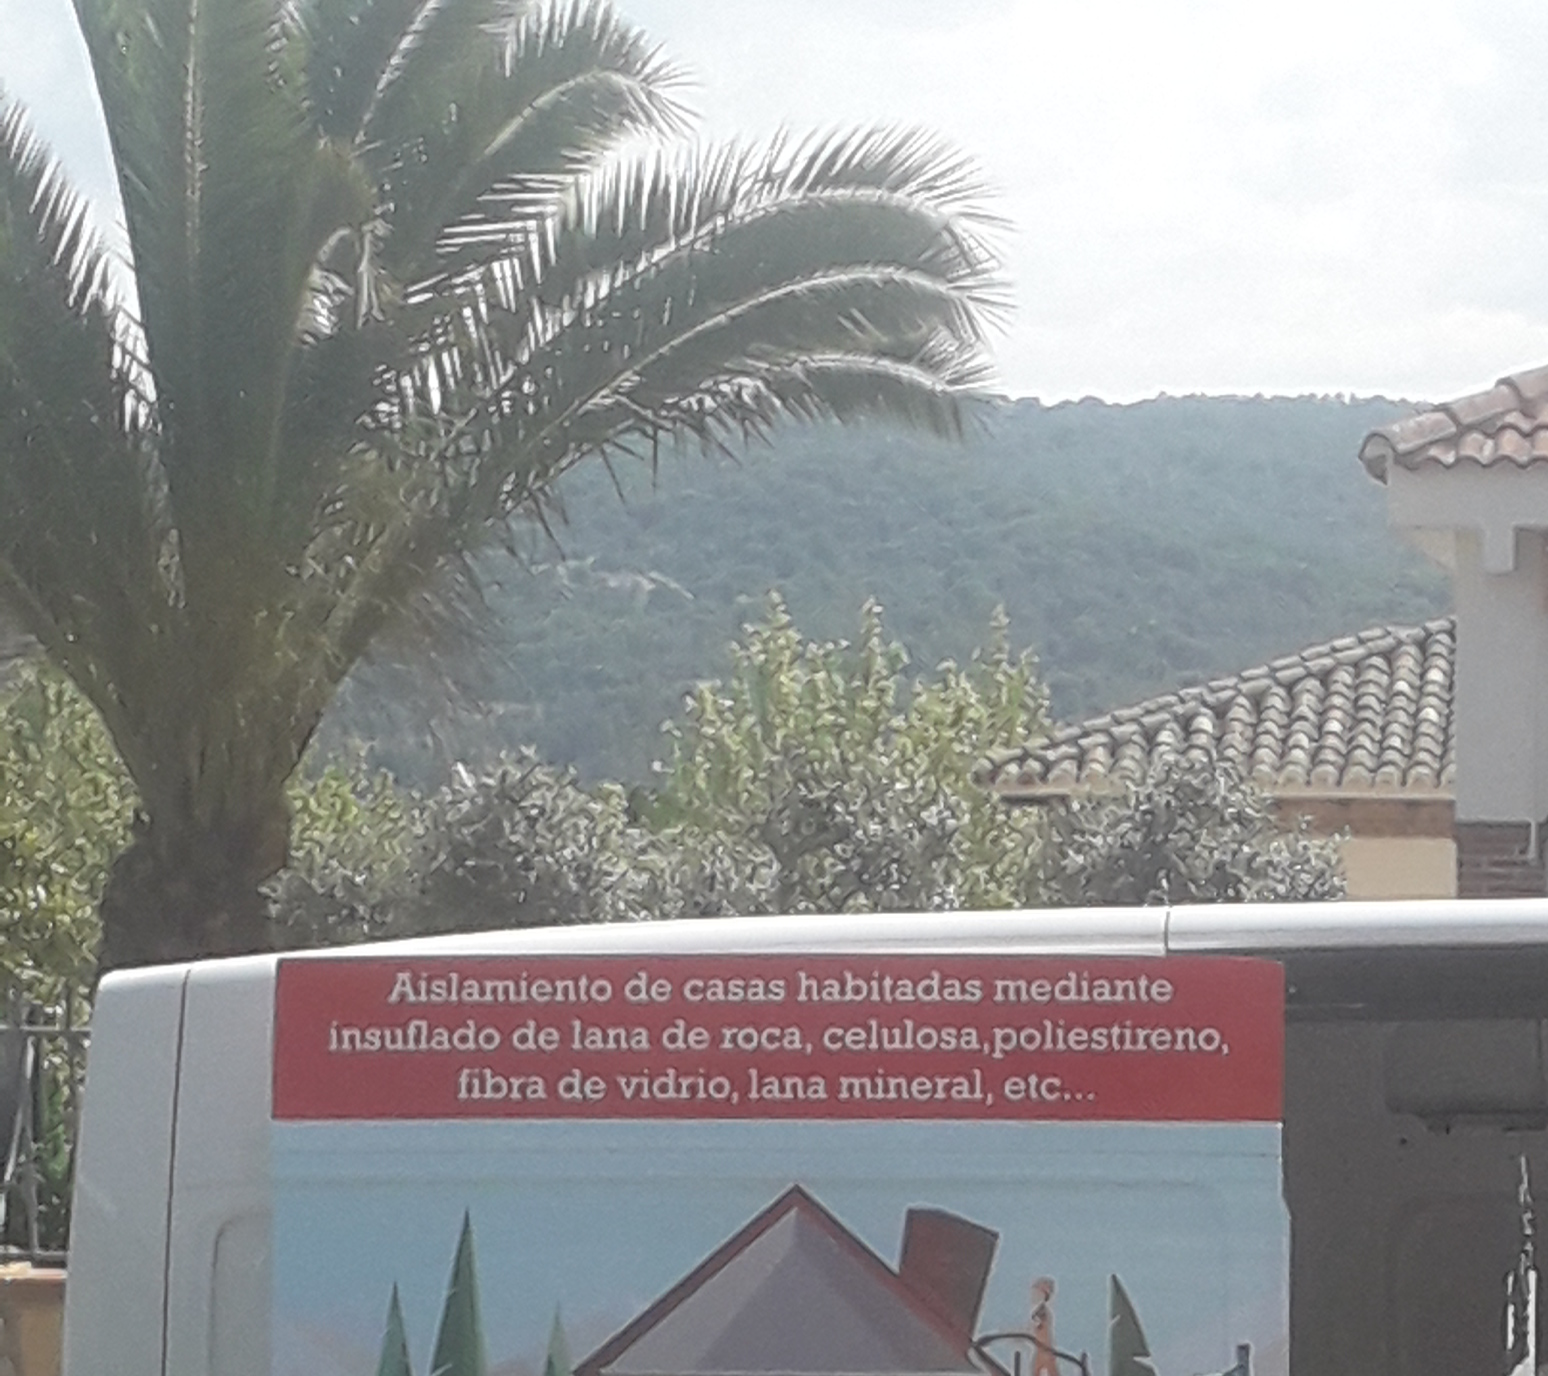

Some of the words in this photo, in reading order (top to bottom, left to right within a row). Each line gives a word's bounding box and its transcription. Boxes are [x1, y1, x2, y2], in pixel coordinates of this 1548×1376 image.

[389, 971, 613, 1003] Aislamiento
[625, 971, 673, 1003] de
[684, 978, 786, 1002] casas
[797, 970, 983, 1003] habitadas
[994, 971, 1173, 1003] mediante
[329, 1019, 501, 1051] insuflado
[512, 1019, 560, 1051] de
[571, 1019, 651, 1050] lana
[662, 1019, 710, 1051] de
[719, 1026, 813, 1055] roca,
[457, 1068, 547, 1100] fibra
[558, 1068, 607, 1100] de
[617, 1068, 739, 1104] vidrio,
[749, 1068, 828, 1100] lana
[838, 1068, 993, 1106] mineral,
[1004, 1074, 1095, 1101] etc...
